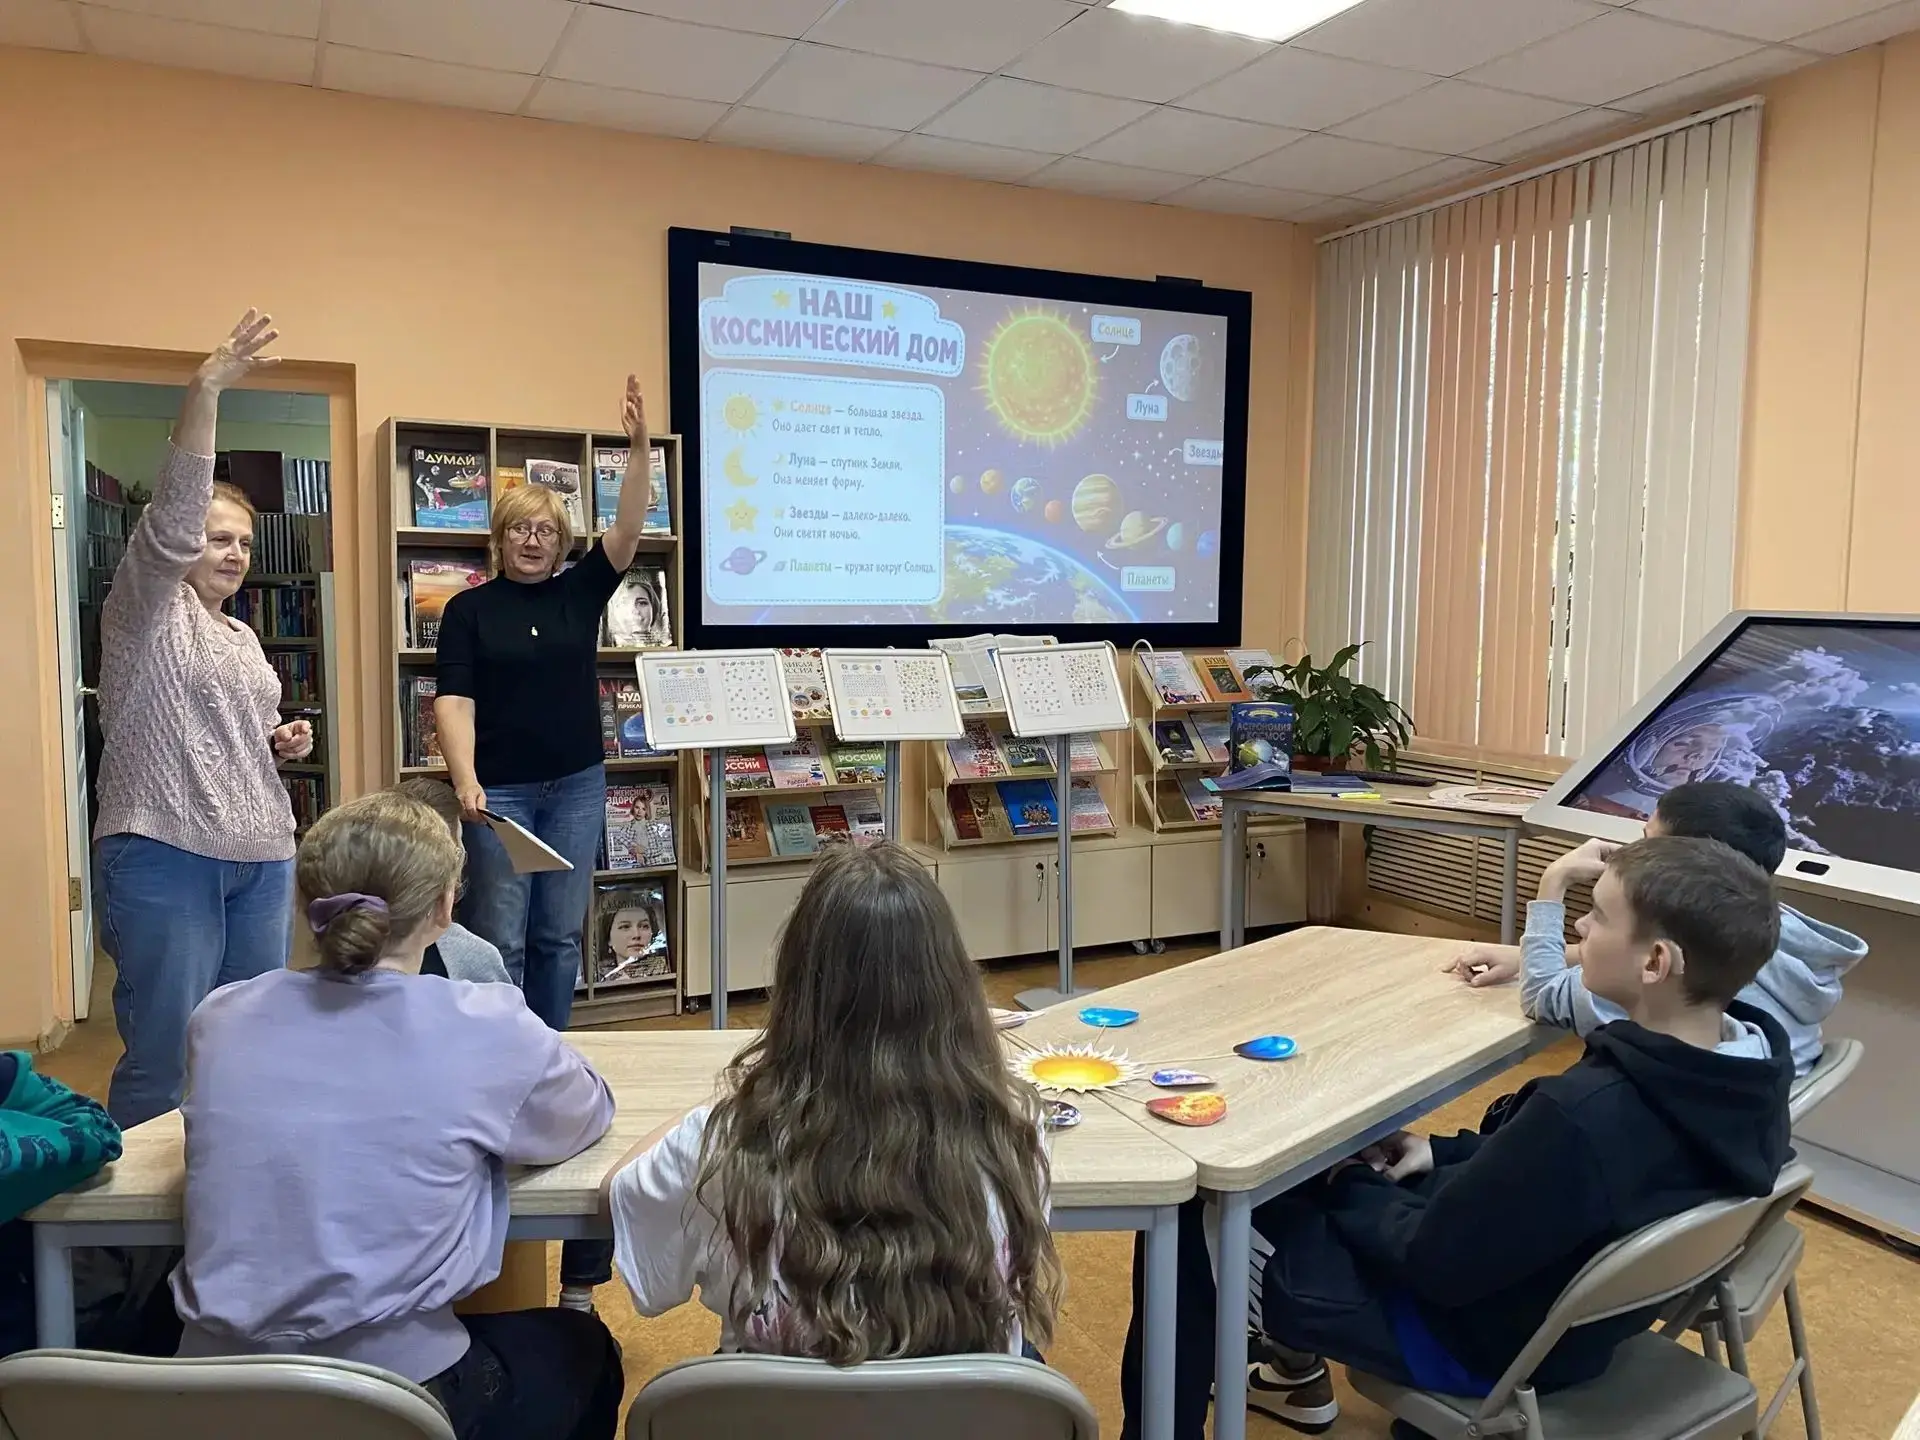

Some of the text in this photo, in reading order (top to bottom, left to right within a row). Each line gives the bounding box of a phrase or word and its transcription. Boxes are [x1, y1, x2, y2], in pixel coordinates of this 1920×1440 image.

[799, 287, 873, 321] НАШ
[1097, 322, 1135, 339] Солнце
[709, 316, 959, 366] КОСМИЧЕСКИЙ ДОМ
[790, 400, 831, 415] Солнце
[848, 404, 888, 418] большая
[891, 409, 925, 421] звезда.
[1134, 400, 1160, 415] Луна
[772, 418, 792, 432] Оно
[819, 424, 841, 435] свет
[844, 426, 850, 435] и
[424, 453, 476, 466] ДУМАЙ
[788, 452, 817, 469] Луна
[831, 457, 868, 471] спутник
[773, 472, 865, 492] Она меняет форму.
[789, 505, 829, 520] Звезды
[842, 511, 912, 523] далеко-далеко.
[773, 526, 794, 539] Они
[796, 529, 827, 540] светят
[789, 558, 832, 573] Планеты
[844, 562, 875, 576] кружат
[876, 562, 901, 576] вокруг
[1127, 571, 1169, 586] Планеты
[617, 692, 641, 702] ЧУД
[1237, 723, 1292, 732] АСТРОНОМИЯ
[1247, 731, 1286, 741] КОСМОС
[838, 753, 882, 763] РОССИИ
[725, 761, 761, 771] ОССИИ
[606, 796, 633, 806] ЗДОРО
